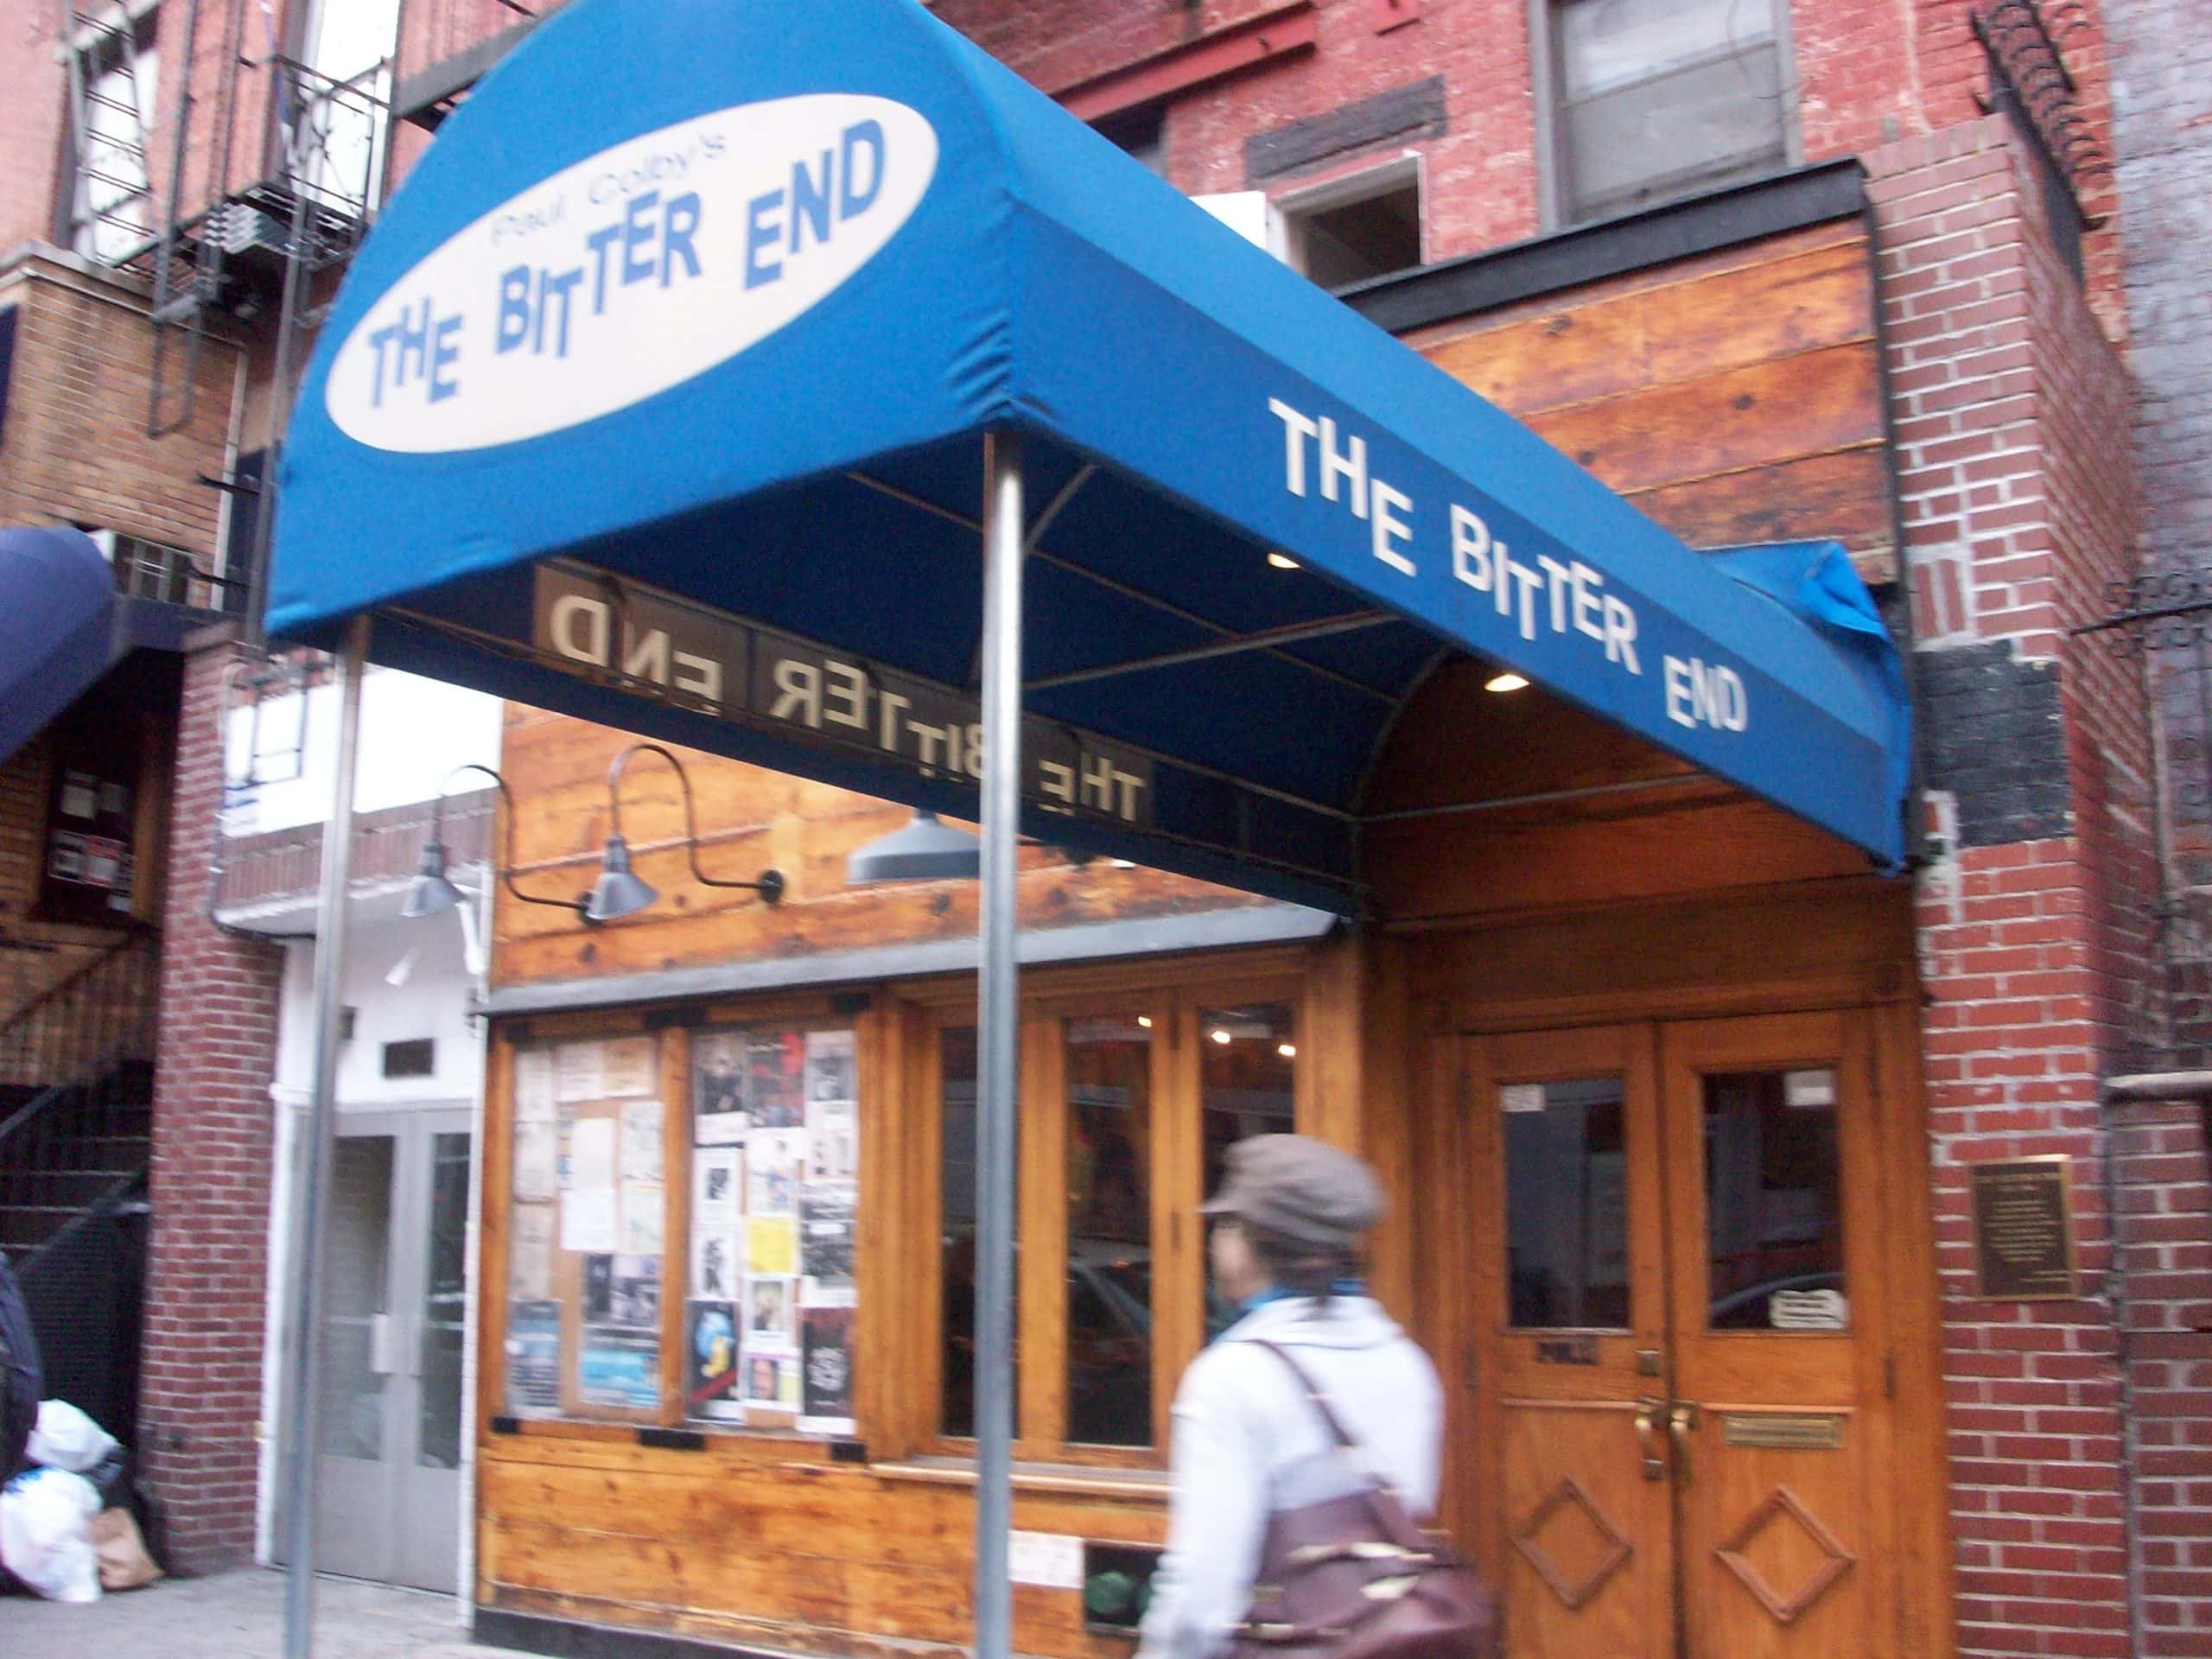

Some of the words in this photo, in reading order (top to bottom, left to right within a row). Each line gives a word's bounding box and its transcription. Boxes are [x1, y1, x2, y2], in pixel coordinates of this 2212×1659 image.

[368, 296, 463, 410] THE
[493, 189, 702, 360] BITTER
[743, 118, 887, 291] END
[1268, 397, 1417, 577] THE
[1450, 503, 1643, 676] BITTER
[1662, 654, 1749, 733] END
